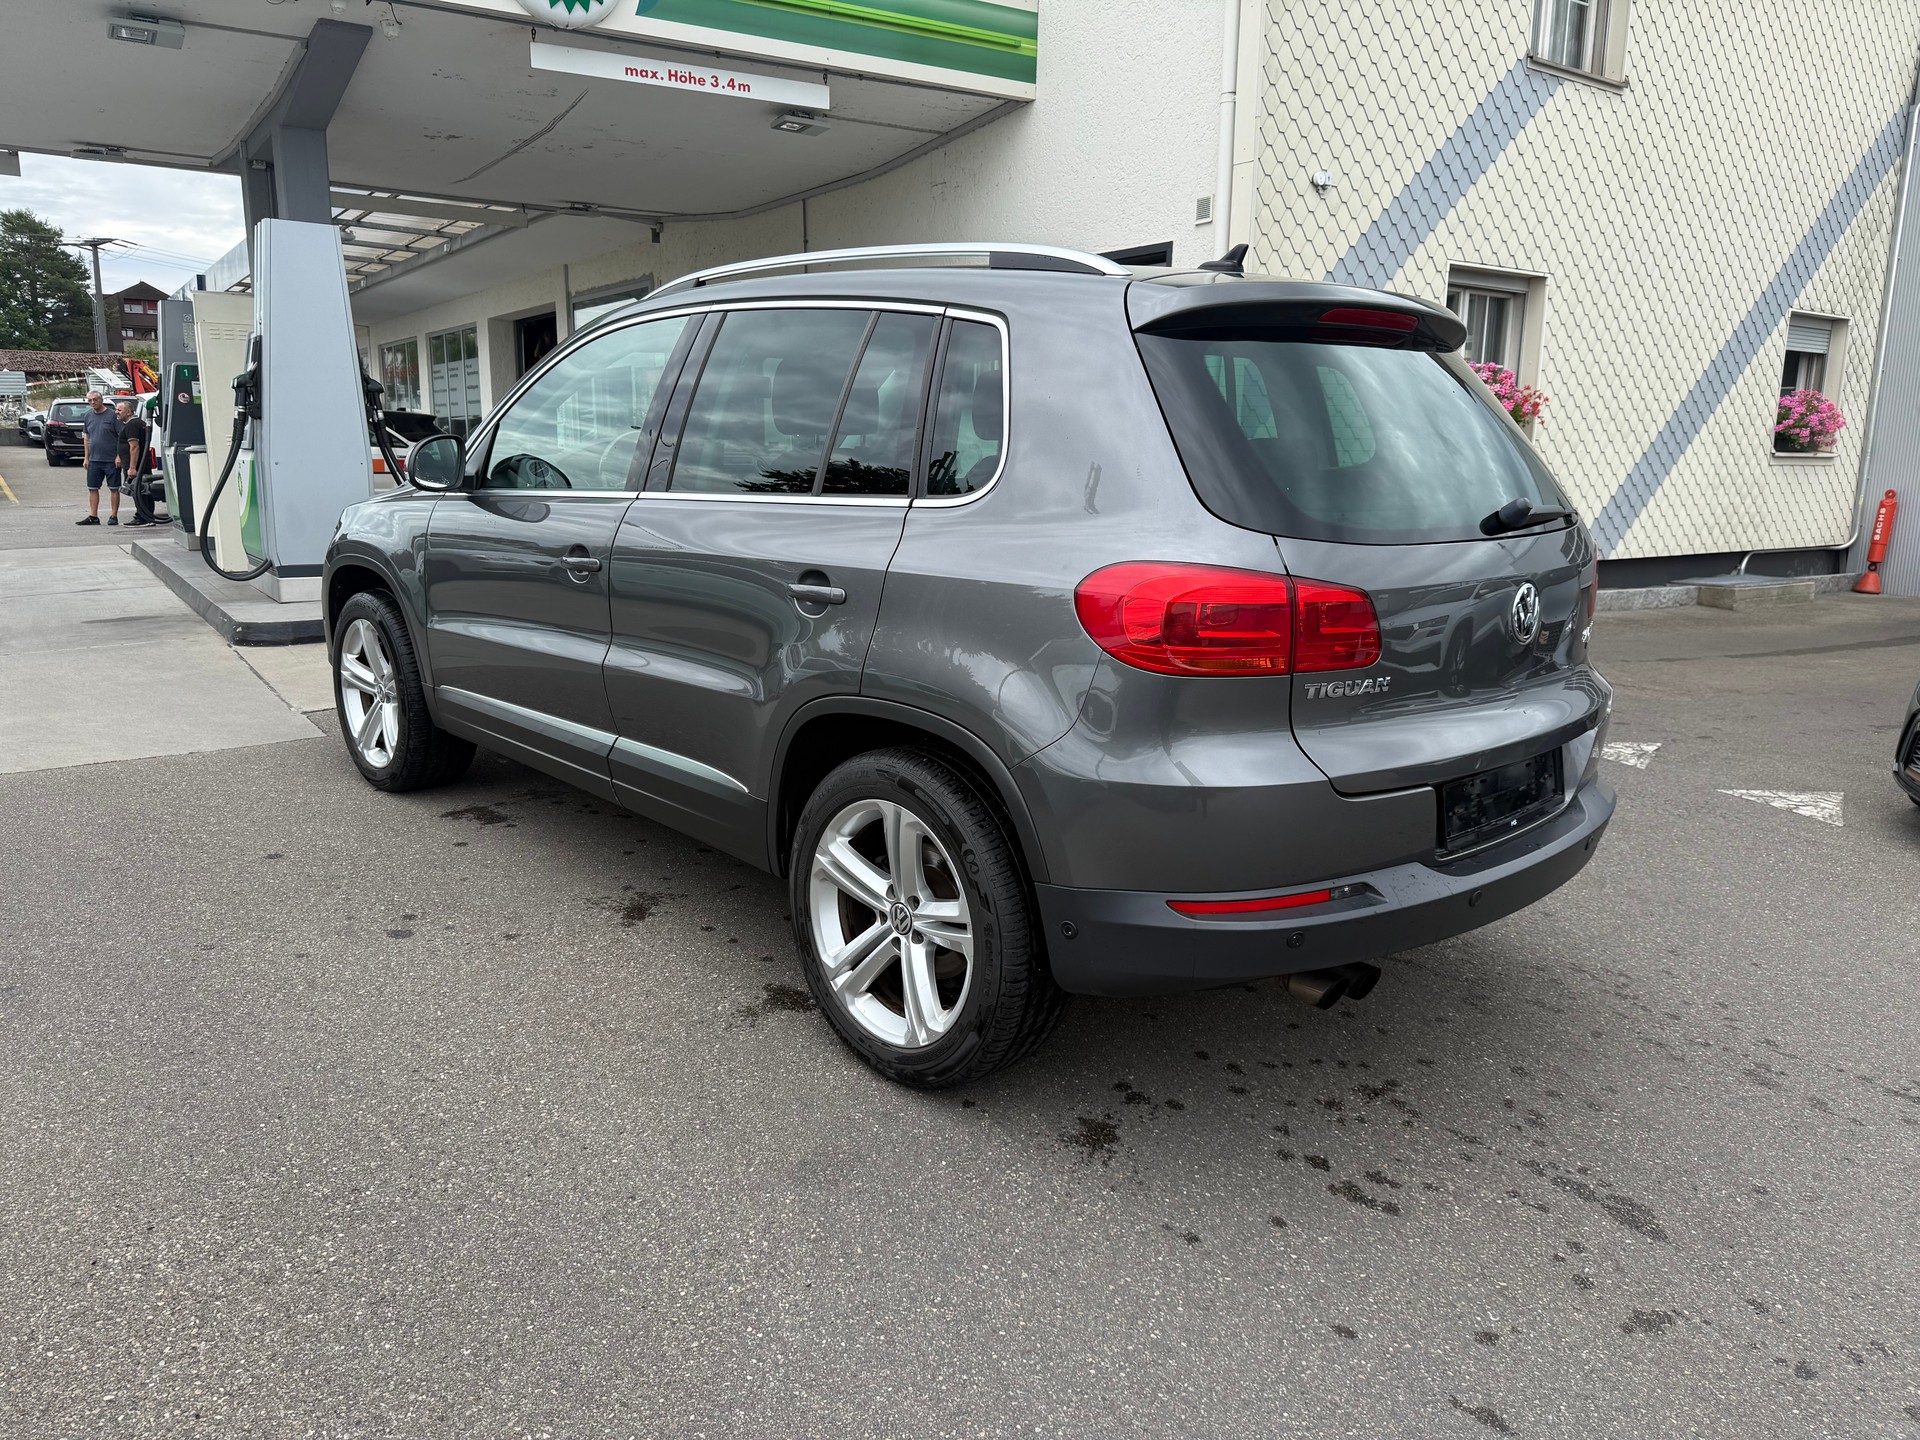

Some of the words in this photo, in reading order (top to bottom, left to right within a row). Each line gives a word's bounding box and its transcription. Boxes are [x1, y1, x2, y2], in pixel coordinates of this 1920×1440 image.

[624, 66, 664, 81] max.
[667, 69, 707, 86] Höhe
[1873, 507, 1887, 541] SACHS
[1304, 676, 1391, 700] TIGUAN
